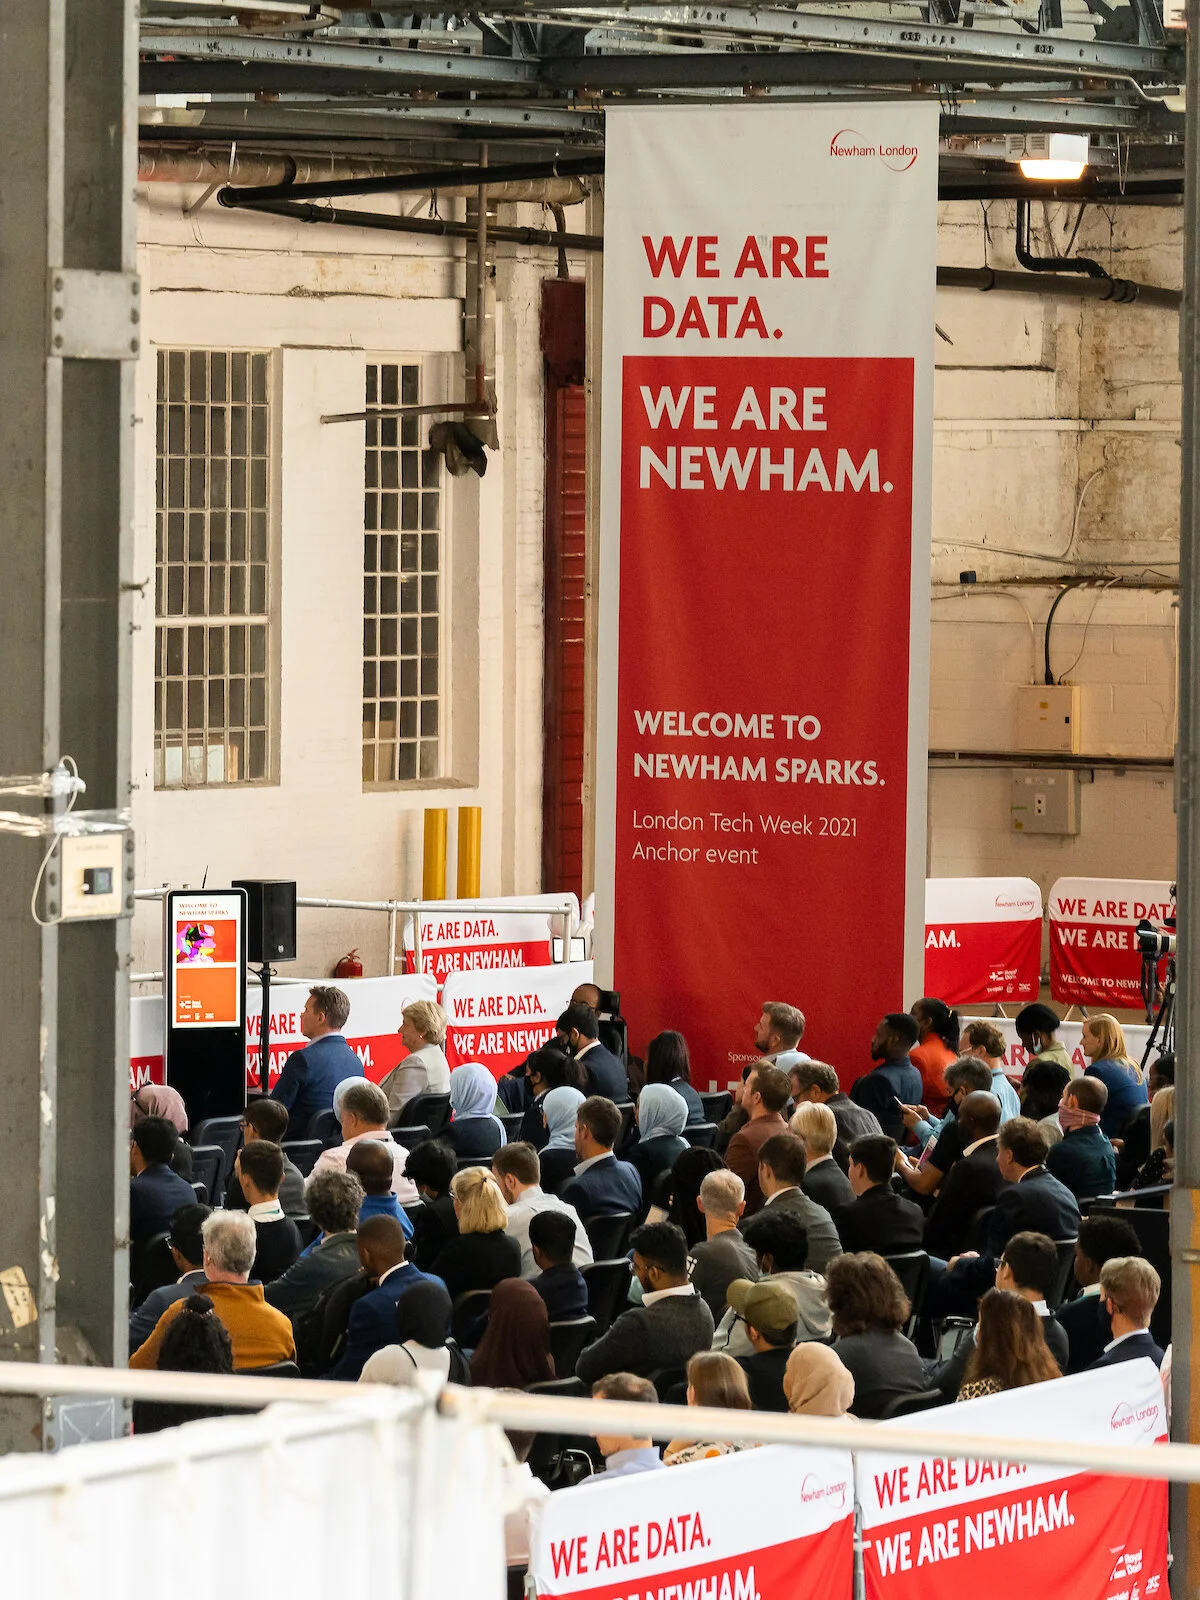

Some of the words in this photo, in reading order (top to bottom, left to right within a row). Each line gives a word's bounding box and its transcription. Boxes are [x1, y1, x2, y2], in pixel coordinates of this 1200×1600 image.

[830, 144, 875, 156] Newham
[879, 144, 918, 156] London
[641, 235, 720, 279] WE
[734, 235, 830, 279] ARE
[642, 296, 783, 339] DATA.
[640, 385, 718, 430] WE
[731, 385, 828, 431] ARE
[639, 445, 894, 493] NEWHAM.
[633, 710, 775, 739] WELCOME
[781, 714, 822, 741] TO
[633, 753, 767, 782] NEWHAM
[775, 758, 886, 786] SPARKS.
[632, 809, 704, 832] London
[710, 812, 753, 833] Tech
[759, 814, 813, 836] Week
[818, 817, 858, 837] 2021
[632, 840, 700, 862] Anchor
[705, 846, 759, 865] event
[1057, 898, 1087, 917] WE
[1092, 900, 1128, 918] ARE
[437, 921, 460, 940] ARE
[464, 919, 499, 938] DATA.
[1058, 928, 1087, 948] WE
[1092, 930, 1129, 950] ARE
[436, 952, 461, 974] ARE
[463, 948, 526, 970] NEWHAM.
[1100, 977, 1115, 987] TO
[453, 997, 474, 1018] WE
[478, 995, 504, 1017] ARE
[507, 993, 547, 1016] DATA.
[269, 1012, 296, 1035] ARE
[453, 1032, 476, 1056] WE
[477, 1030, 504, 1055] ARE
[1111, 1413, 1135, 1430] Newham
[1136, 1404, 1159, 1421] London
[801, 1487, 825, 1503] Newham
[826, 1481, 847, 1496] London
[874, 1466, 910, 1510] WE
[917, 1457, 959, 1499] ARE
[550, 1535, 589, 1579] WE
[595, 1525, 640, 1571] ARE
[647, 1511, 712, 1560] DATA.
[875, 1531, 912, 1577] WE
[917, 1519, 960, 1567] ARE
[964, 1489, 1075, 1554] NEWHAM.
